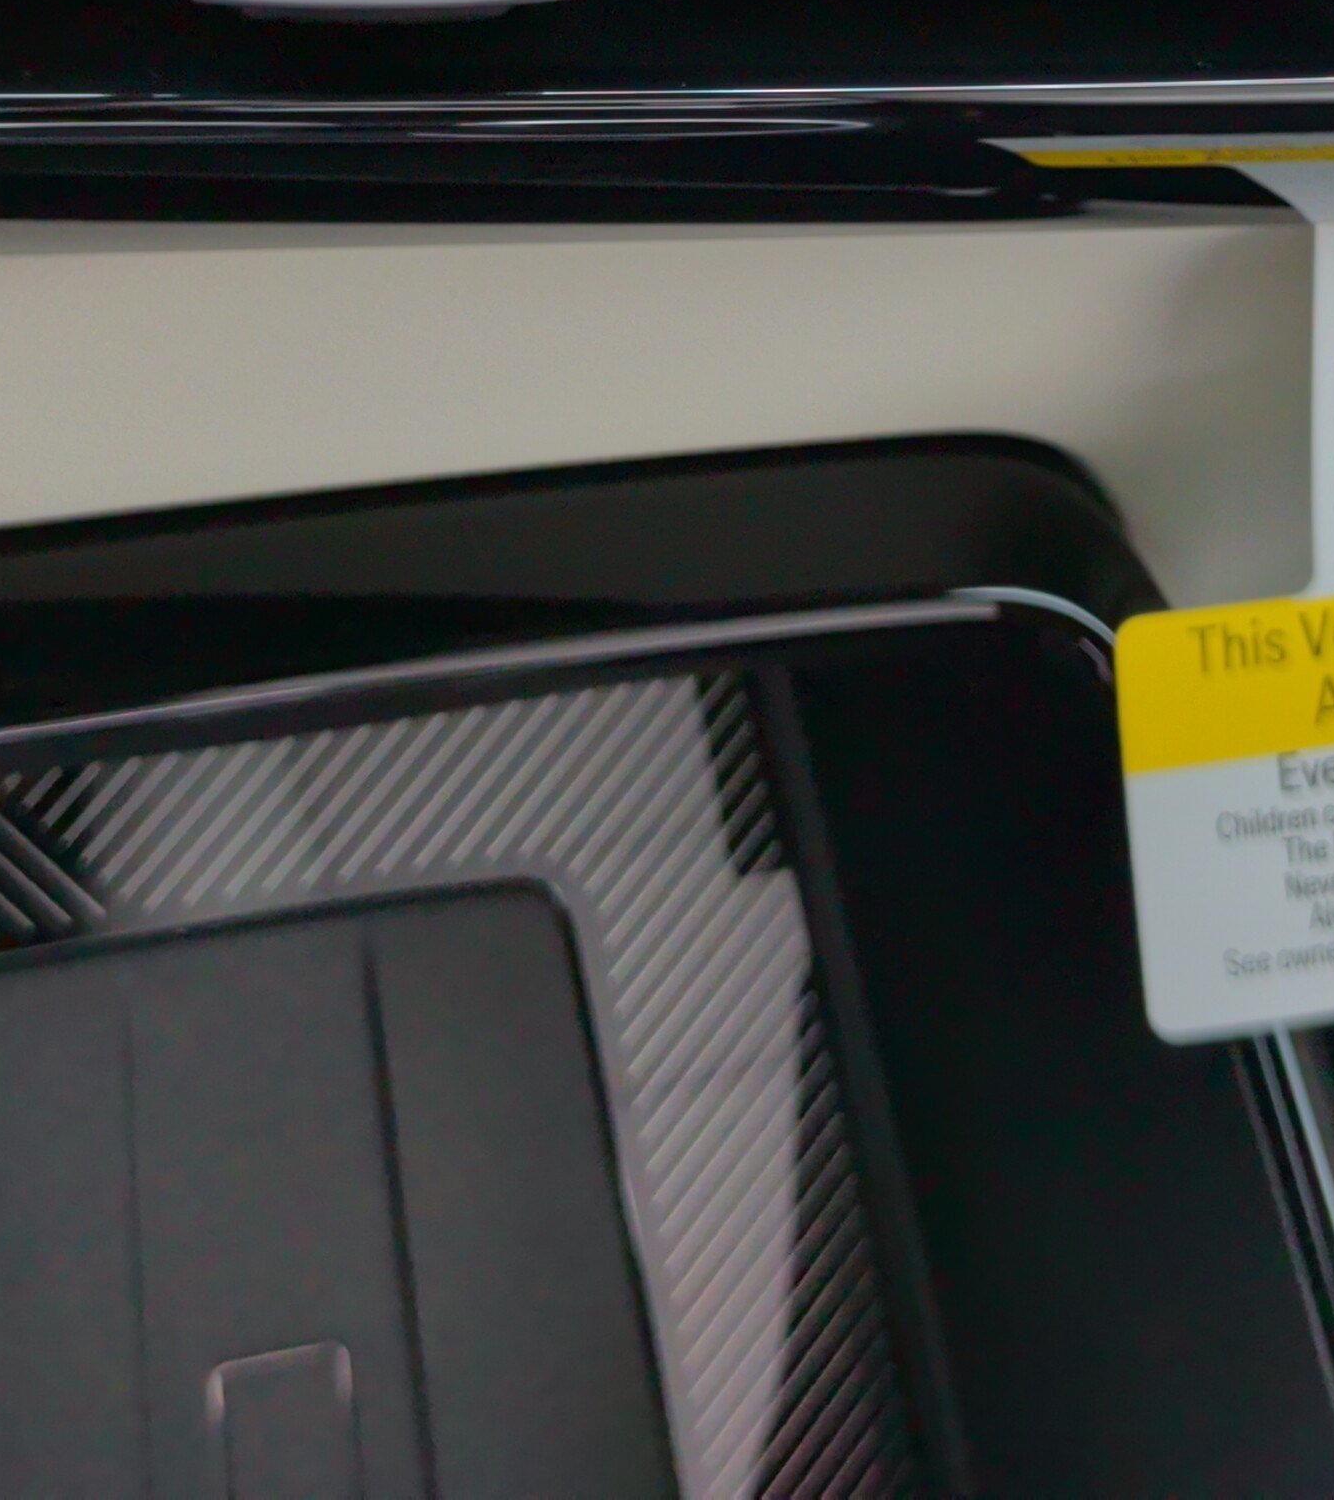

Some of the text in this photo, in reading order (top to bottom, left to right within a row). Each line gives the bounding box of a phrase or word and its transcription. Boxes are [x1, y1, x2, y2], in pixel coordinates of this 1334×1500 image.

[1188, 615, 1287, 673] This
[1216, 806, 1317, 841] Children
[1283, 833, 1330, 863] The
[1223, 947, 1272, 977] See
